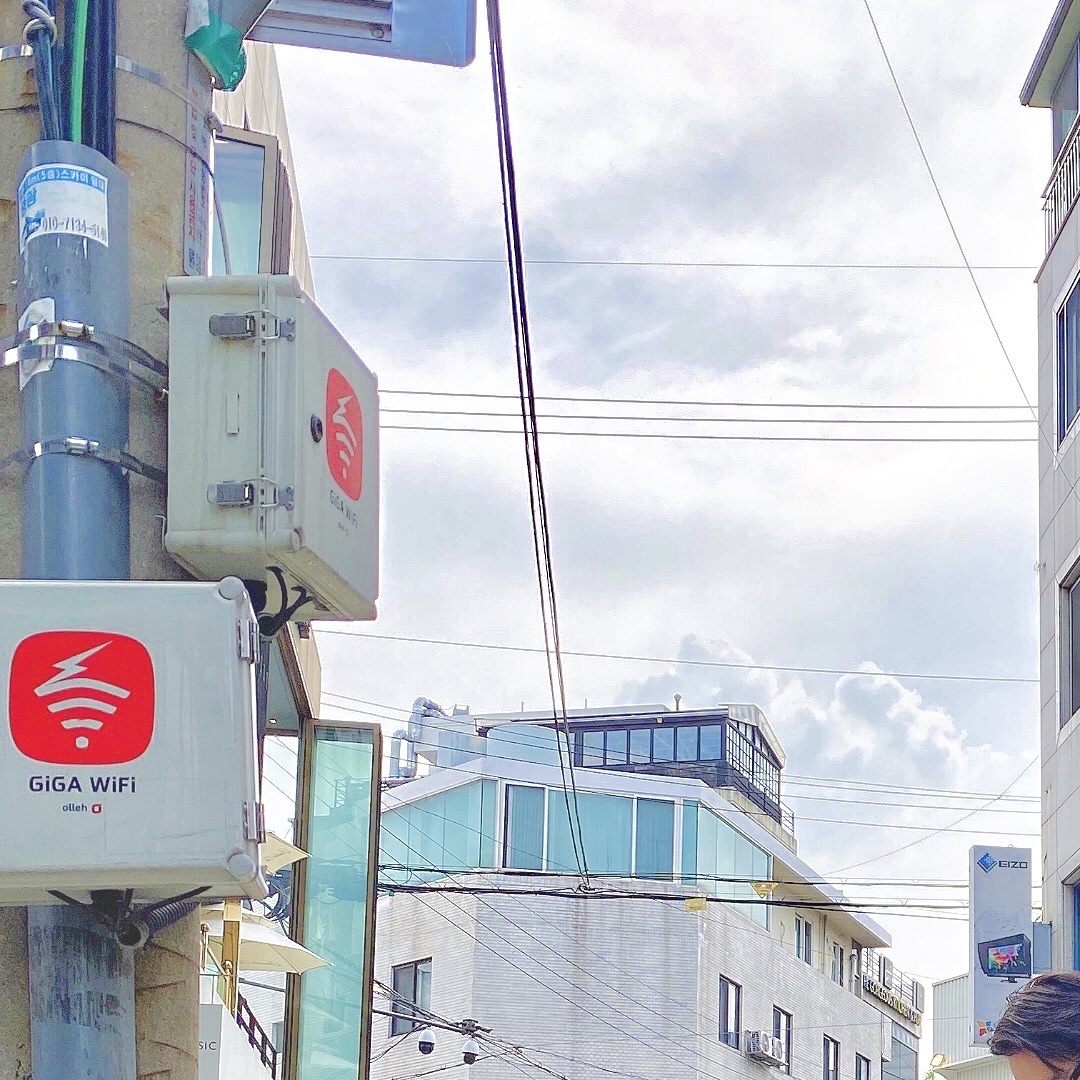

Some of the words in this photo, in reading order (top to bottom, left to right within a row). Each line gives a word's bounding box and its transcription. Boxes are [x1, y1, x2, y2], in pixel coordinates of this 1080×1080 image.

[29, 775, 82, 792] GiGA
[90, 776, 136, 793] WiFi
[62, 803, 88, 812] olleh
[998, 860, 1028, 869] EIZO
